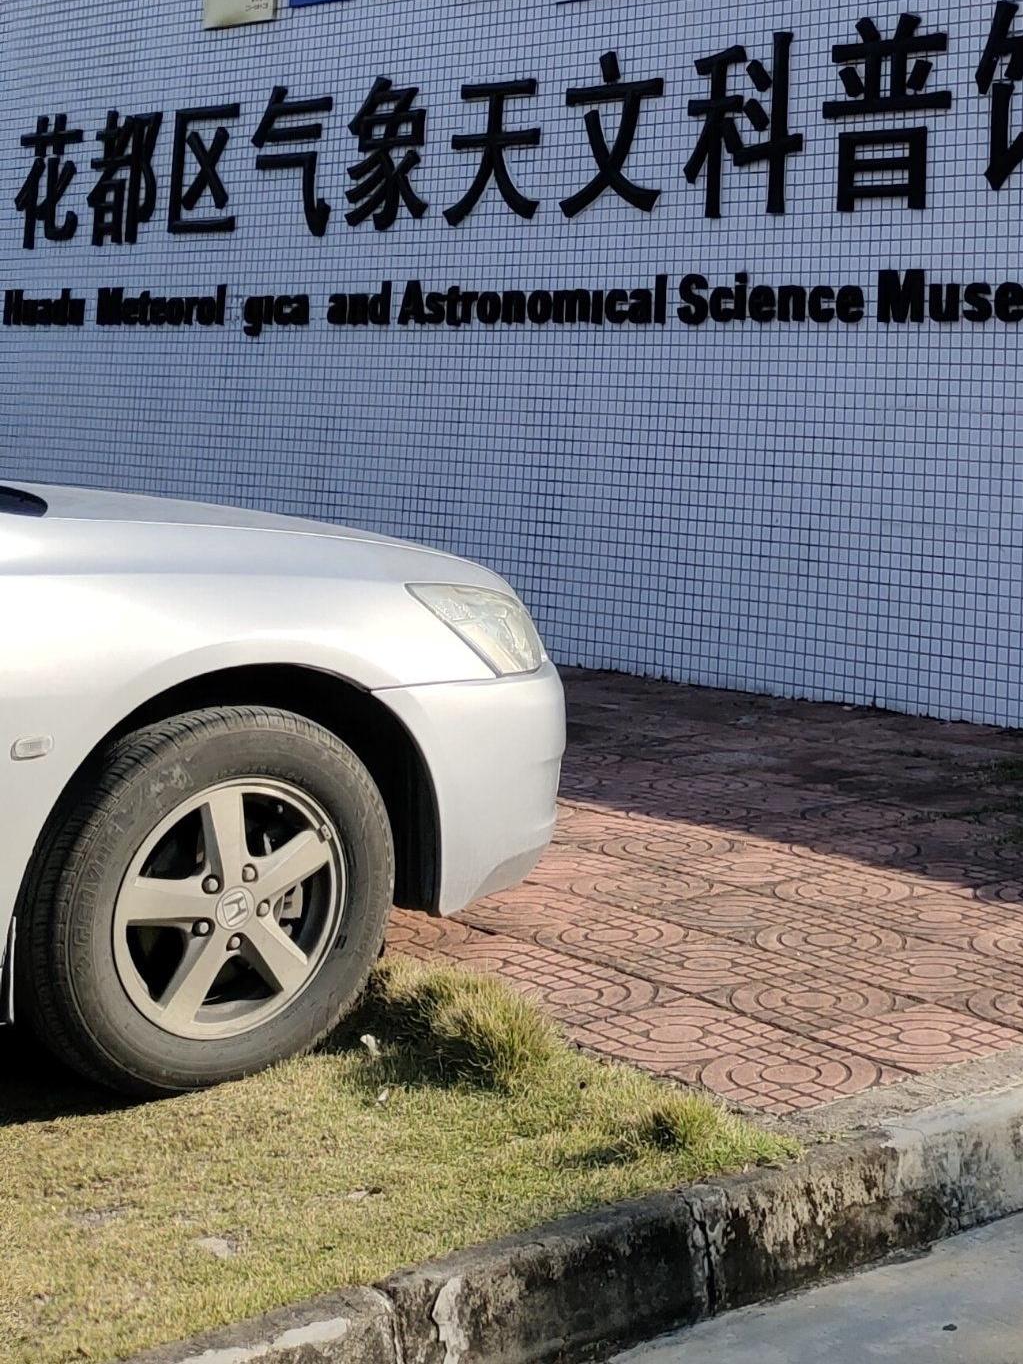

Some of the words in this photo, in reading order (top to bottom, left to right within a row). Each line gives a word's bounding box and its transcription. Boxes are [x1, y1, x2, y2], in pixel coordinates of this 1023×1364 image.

[327, 281, 392, 326] and
[398, 275, 668, 327] Astronomical
[677, 273, 865, 325] Science
